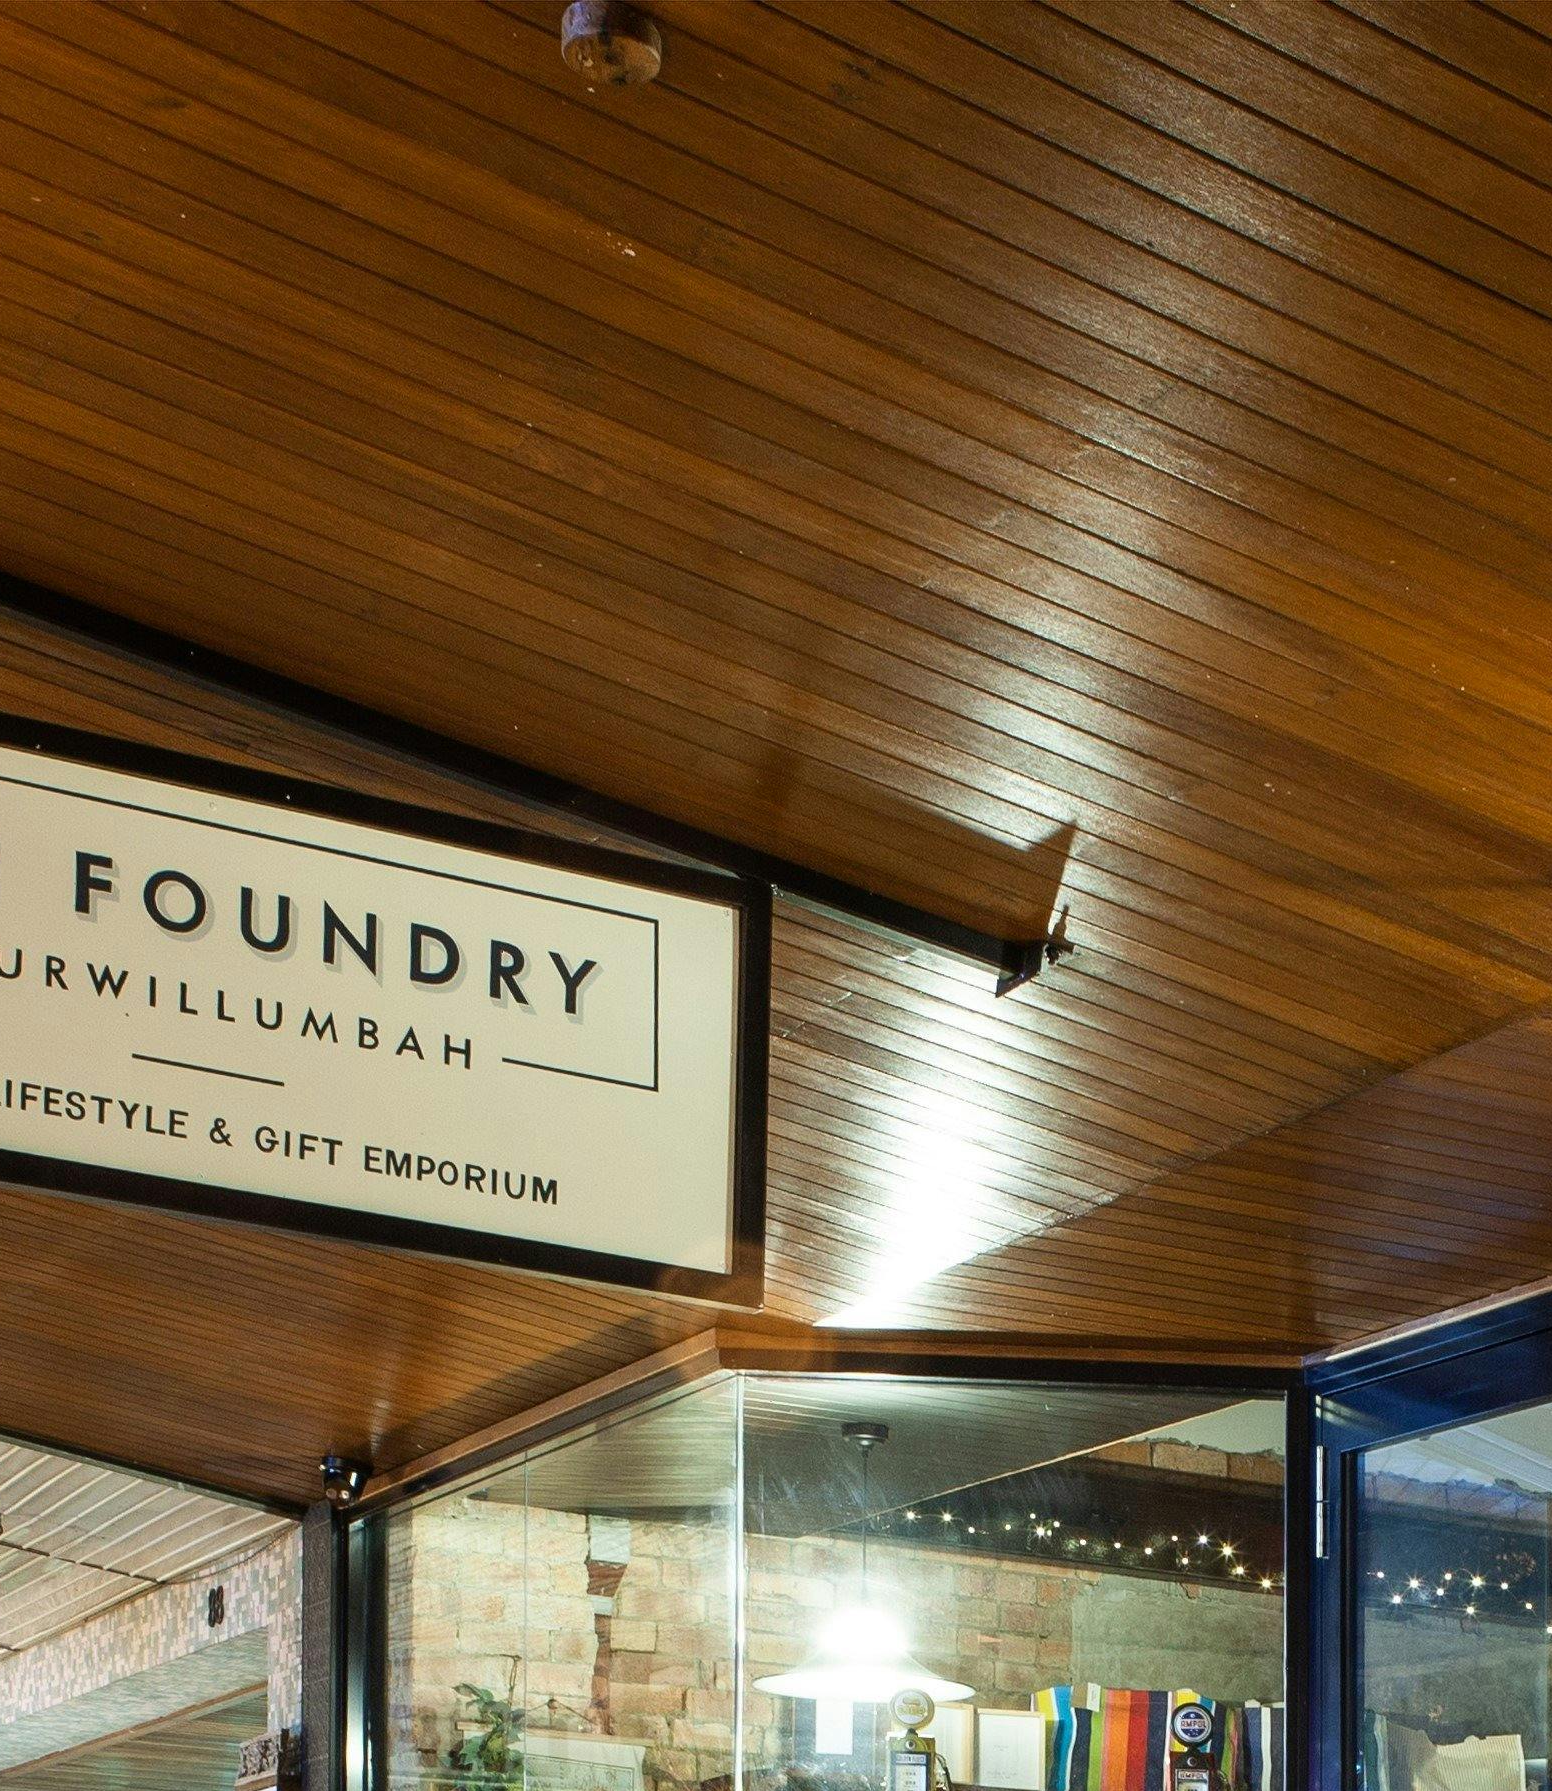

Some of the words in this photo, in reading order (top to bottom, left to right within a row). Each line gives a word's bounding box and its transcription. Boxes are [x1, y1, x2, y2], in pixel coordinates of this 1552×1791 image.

[74, 850, 602, 1022] FOUNDRY
[209, 1117, 234, 1148] &
[254, 1125, 344, 1167] GIFT
[363, 1145, 559, 1206] EMPORIUM
